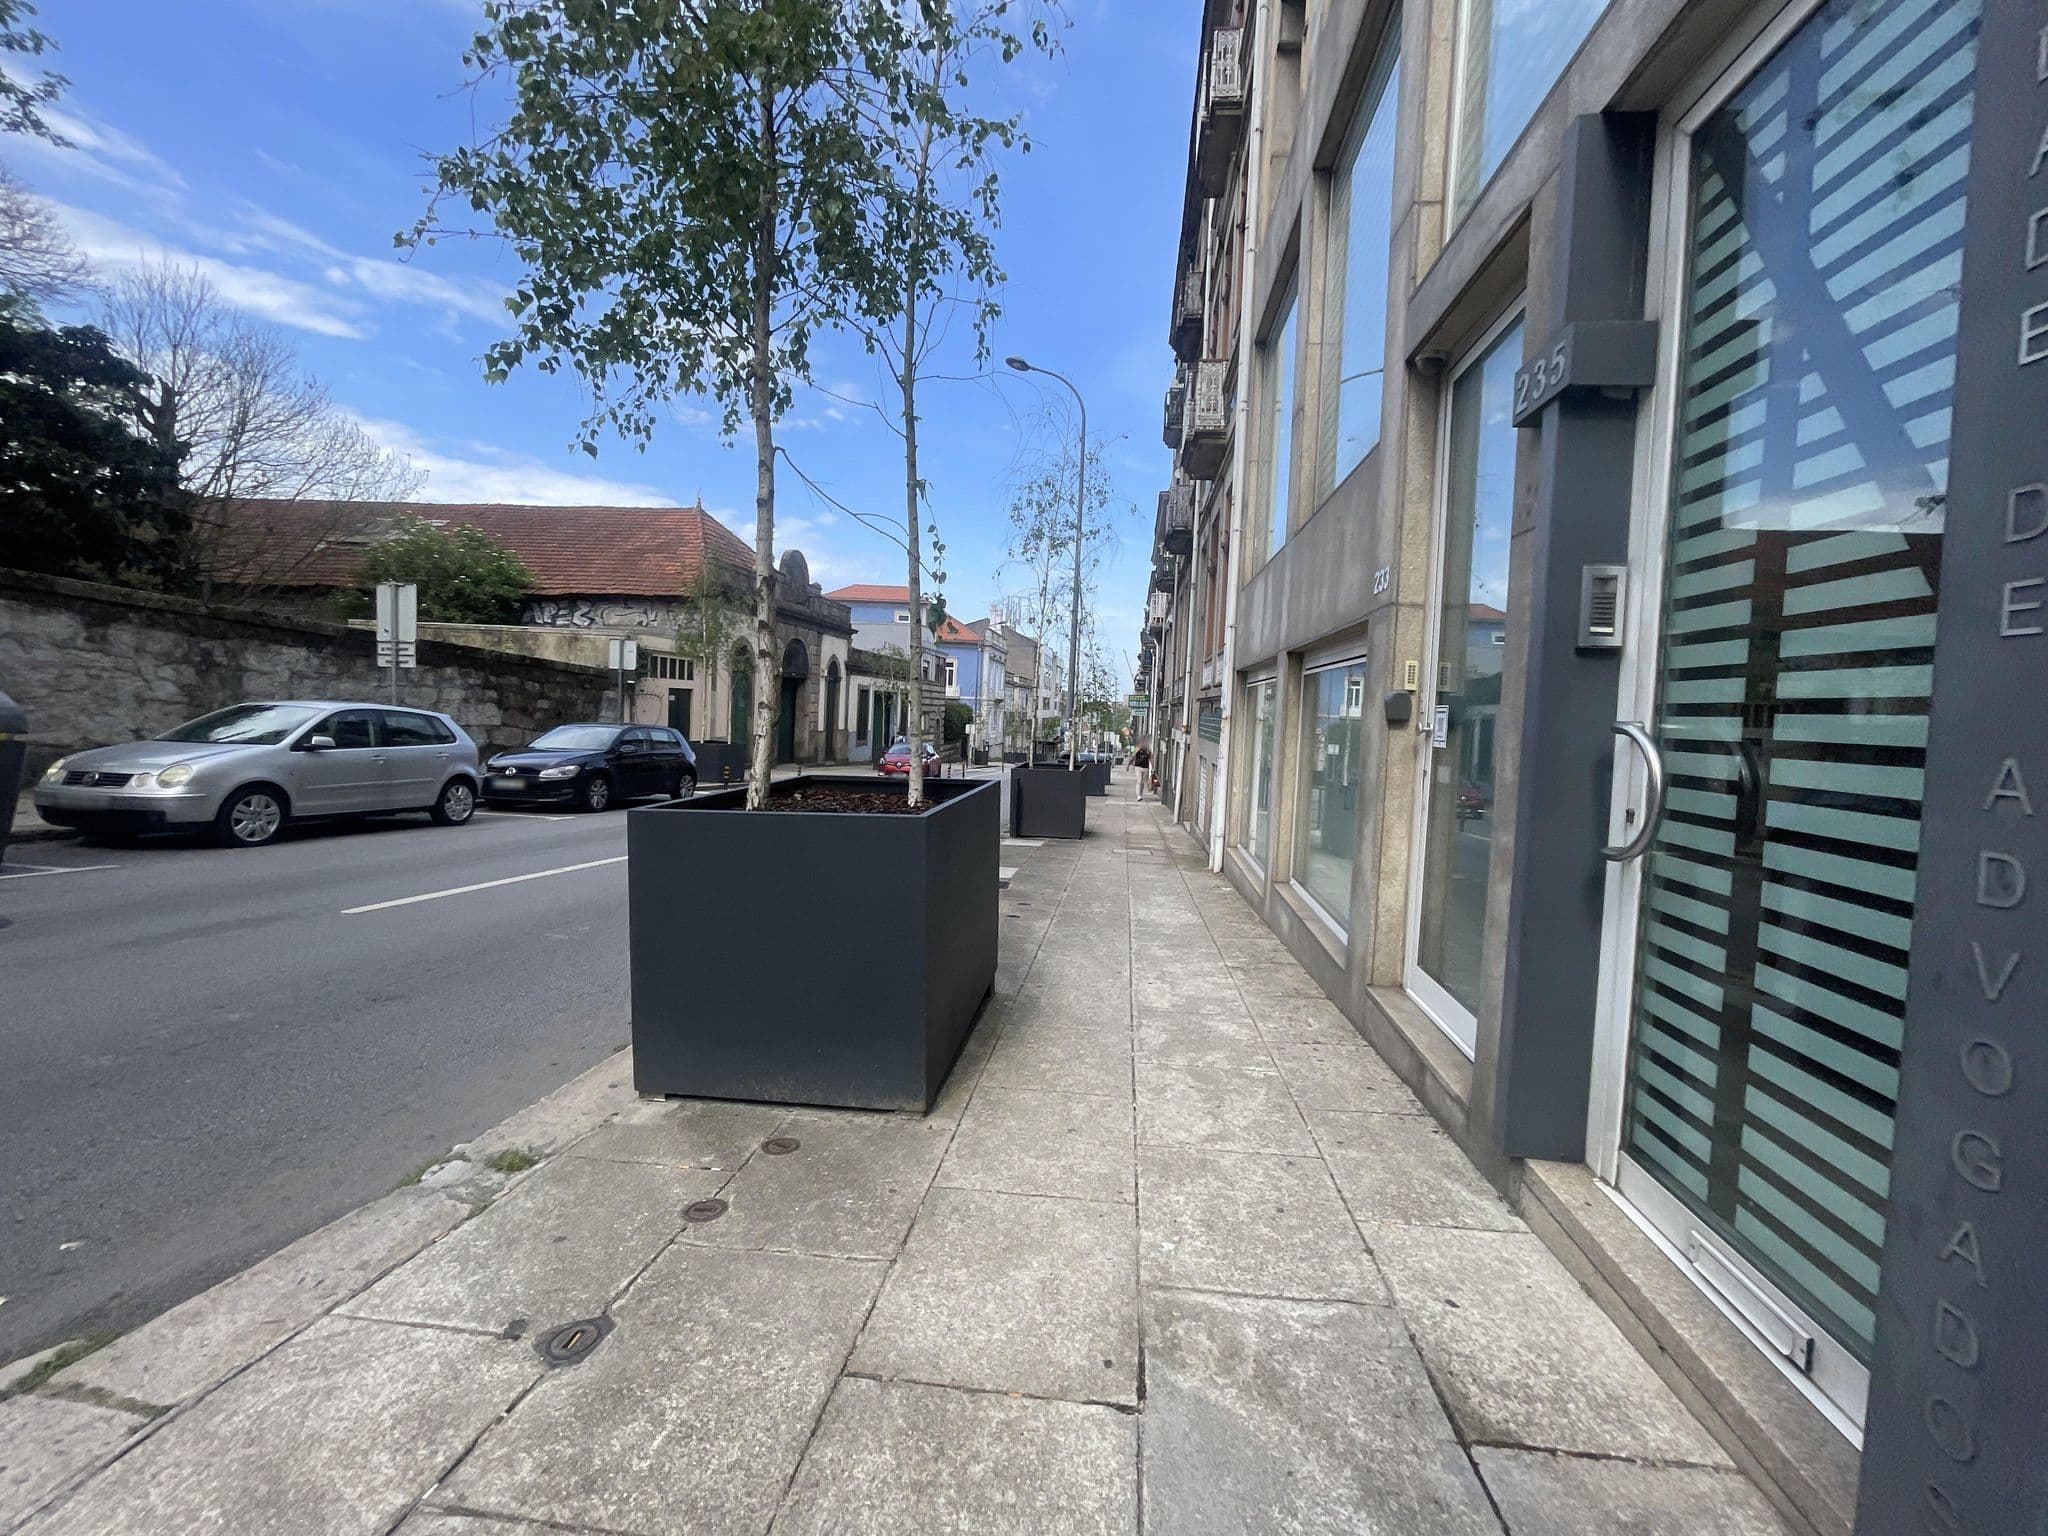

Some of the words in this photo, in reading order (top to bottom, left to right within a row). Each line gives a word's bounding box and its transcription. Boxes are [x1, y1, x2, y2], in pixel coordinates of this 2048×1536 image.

[1515, 340, 1566, 415] 235
[1373, 566, 1390, 595] 233
[2000, 482, 2048, 637] DE
[1920, 757, 2035, 1532] ADVOGADOS
